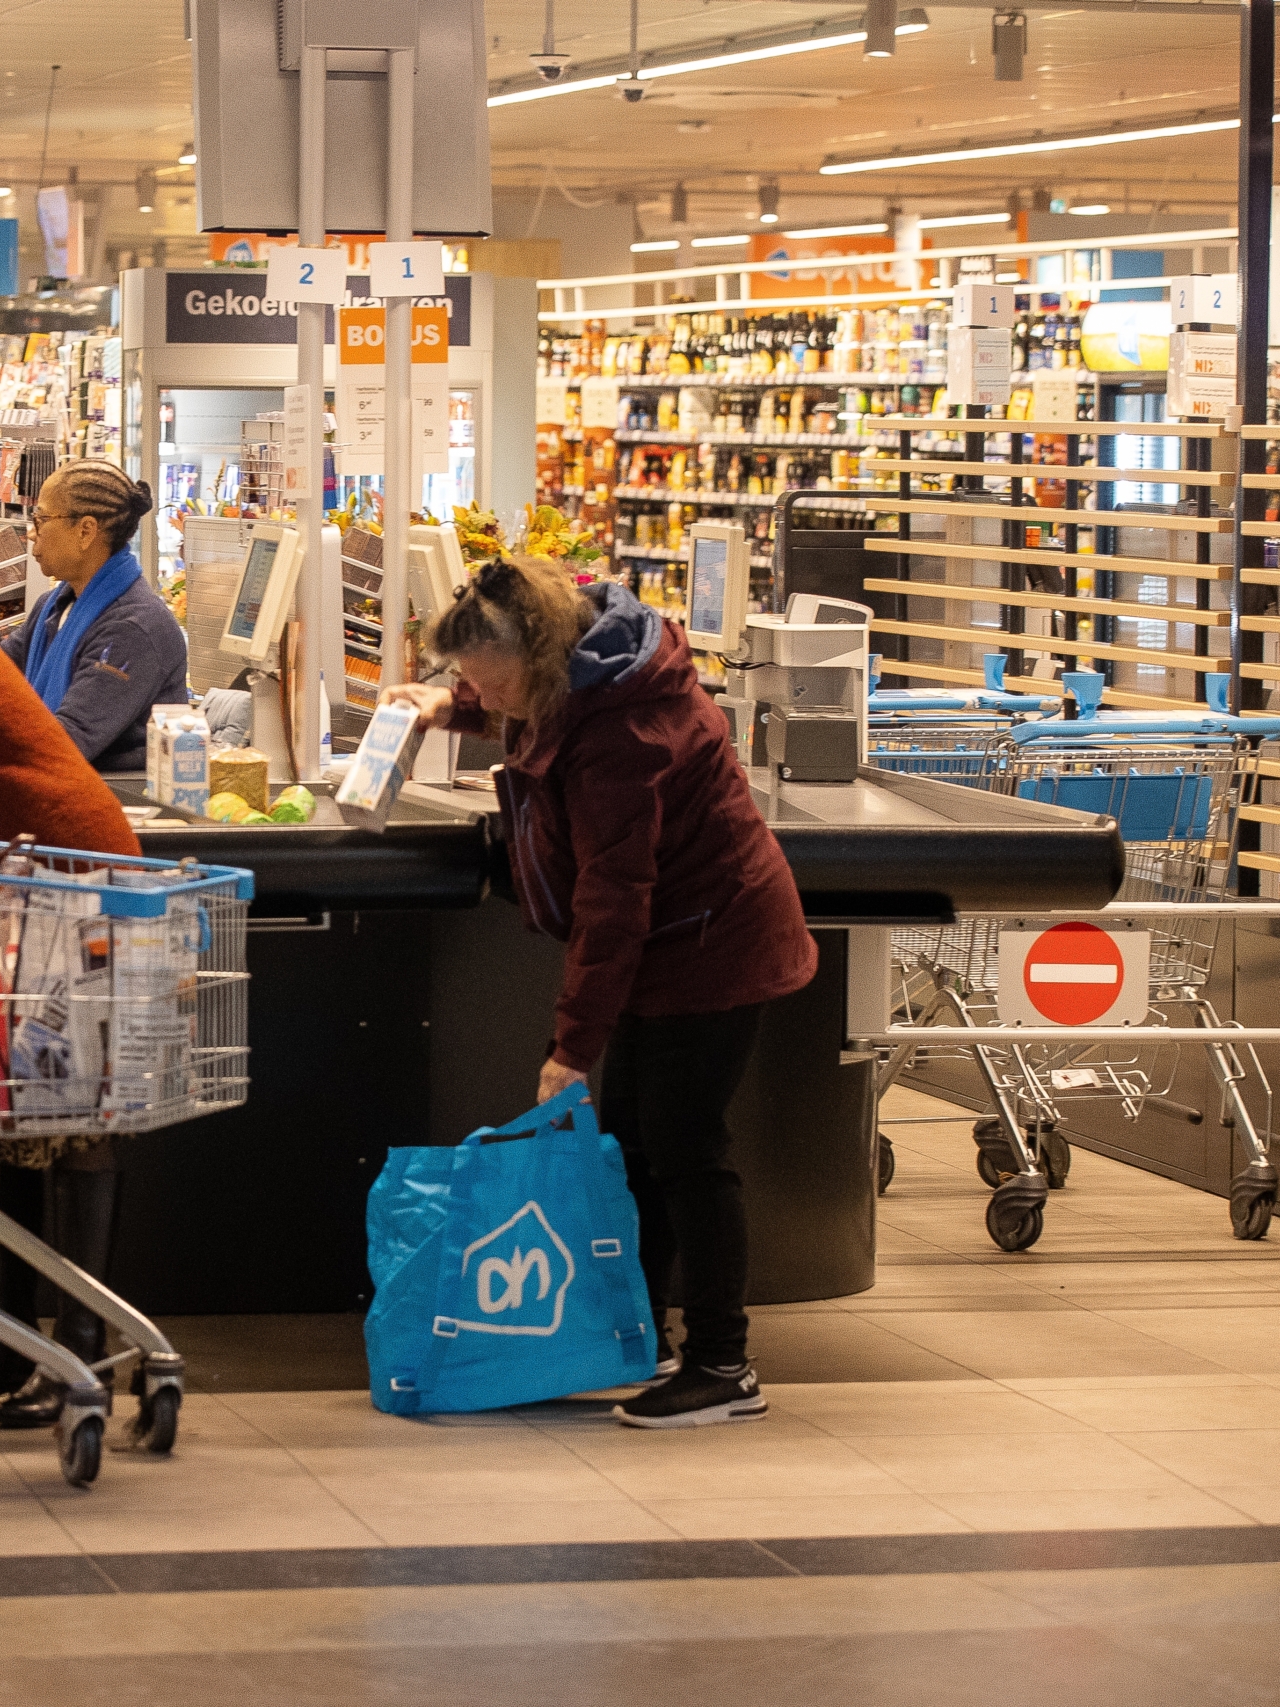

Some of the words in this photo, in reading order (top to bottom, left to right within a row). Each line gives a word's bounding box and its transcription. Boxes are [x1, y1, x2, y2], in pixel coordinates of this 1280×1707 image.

[299, 263, 314, 285] 2
[401, 257, 415, 279] 1
[795, 248, 924, 283] BONU
[990, 296, 998, 314] 1
[1179, 290, 1186, 309] 2
[1213, 290, 1222, 309] 2
[347, 323, 441, 347] BOUS
